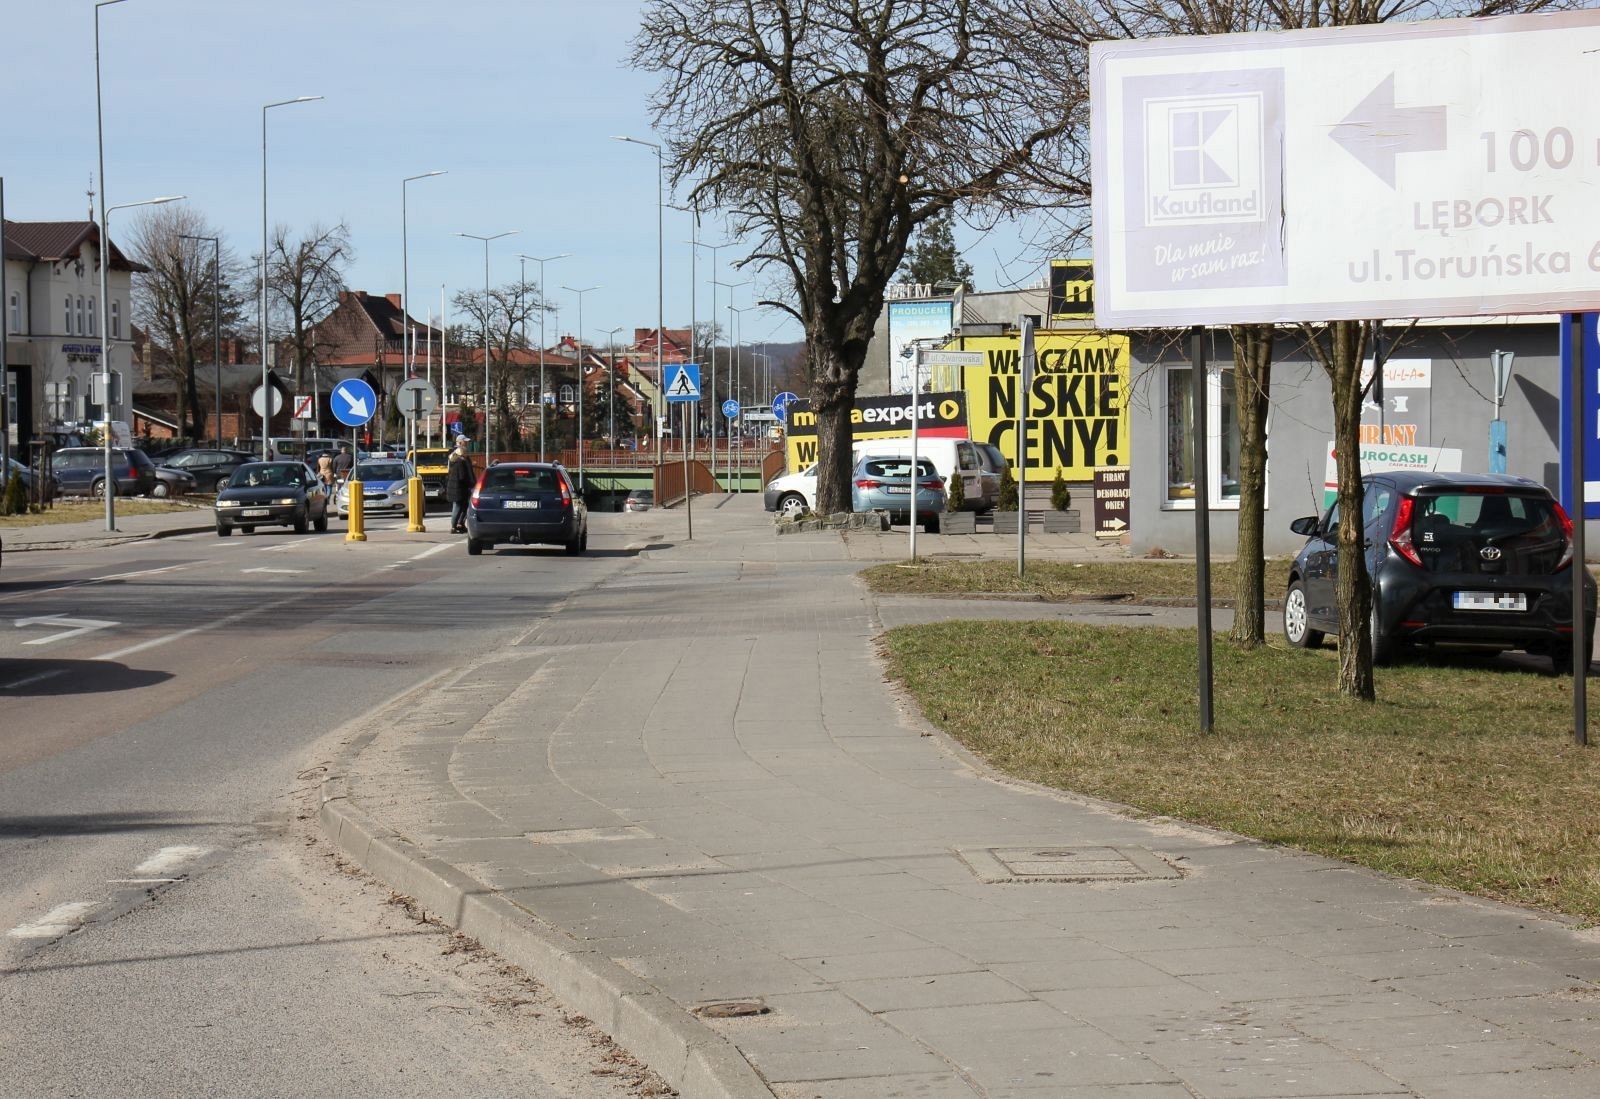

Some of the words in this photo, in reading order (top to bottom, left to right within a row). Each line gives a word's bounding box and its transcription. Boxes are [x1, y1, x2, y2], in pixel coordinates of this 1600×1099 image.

[1480, 126, 1574, 172] 100
[1153, 190, 1256, 216] Kaufland
[1413, 194, 1554, 237] LĘBORK
[1154, 243, 1186, 266] Dla
[1189, 232, 1237, 257] mnie
[1171, 264, 1188, 282] w
[1190, 260, 1227, 279] sam
[1230, 243, 1266, 269] raz!
[892, 306, 948, 315] PRODUCENT
[988, 349, 1120, 376] WŁCZAMY
[793, 401, 935, 426] maexpert
[988, 419, 1119, 468] CENY!
[1360, 424, 1417, 446] IRANY
[1360, 451, 1428, 464] UROCASH
[1103, 472, 1126, 482] FIRANY
[1105, 500, 1125, 510] OKIEN
